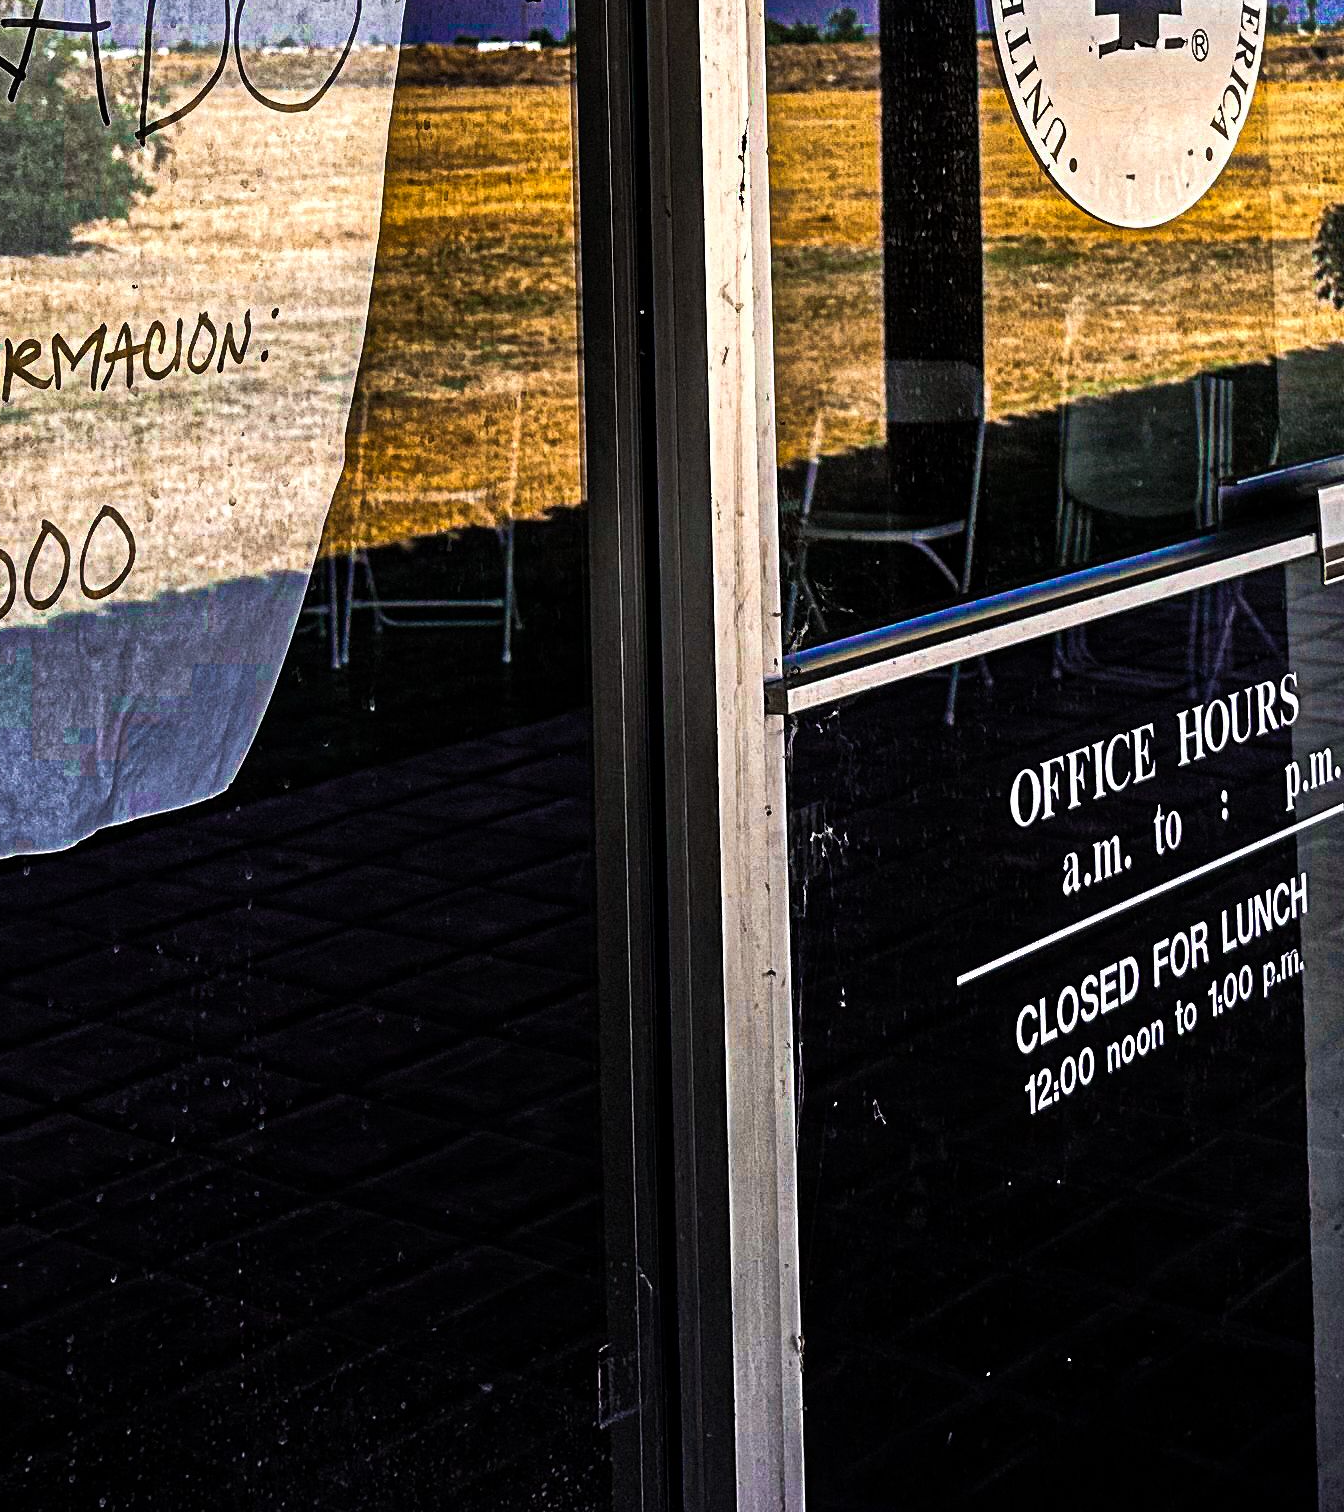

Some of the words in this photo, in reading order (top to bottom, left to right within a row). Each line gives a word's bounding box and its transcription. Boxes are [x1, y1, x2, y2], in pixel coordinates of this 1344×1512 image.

[1010, 724, 1156, 828] OFFICE
[1177, 672, 1299, 768] HOURS
[1062, 835, 1132, 897] a.m.
[1154, 803, 1182, 856] to
[1285, 744, 1342, 812] p.m.
[1015, 956, 1139, 1055] CLOSED
[1153, 921, 1209, 989] FOR
[1221, 872, 1309, 955] LUNCH
[1024, 1046, 1095, 1115] 12:00
[1106, 1018, 1164, 1074] noon
[1175, 999, 1198, 1037] to
[1208, 965, 1253, 1017] 1:00
[1263, 947, 1305, 997] p.m.
